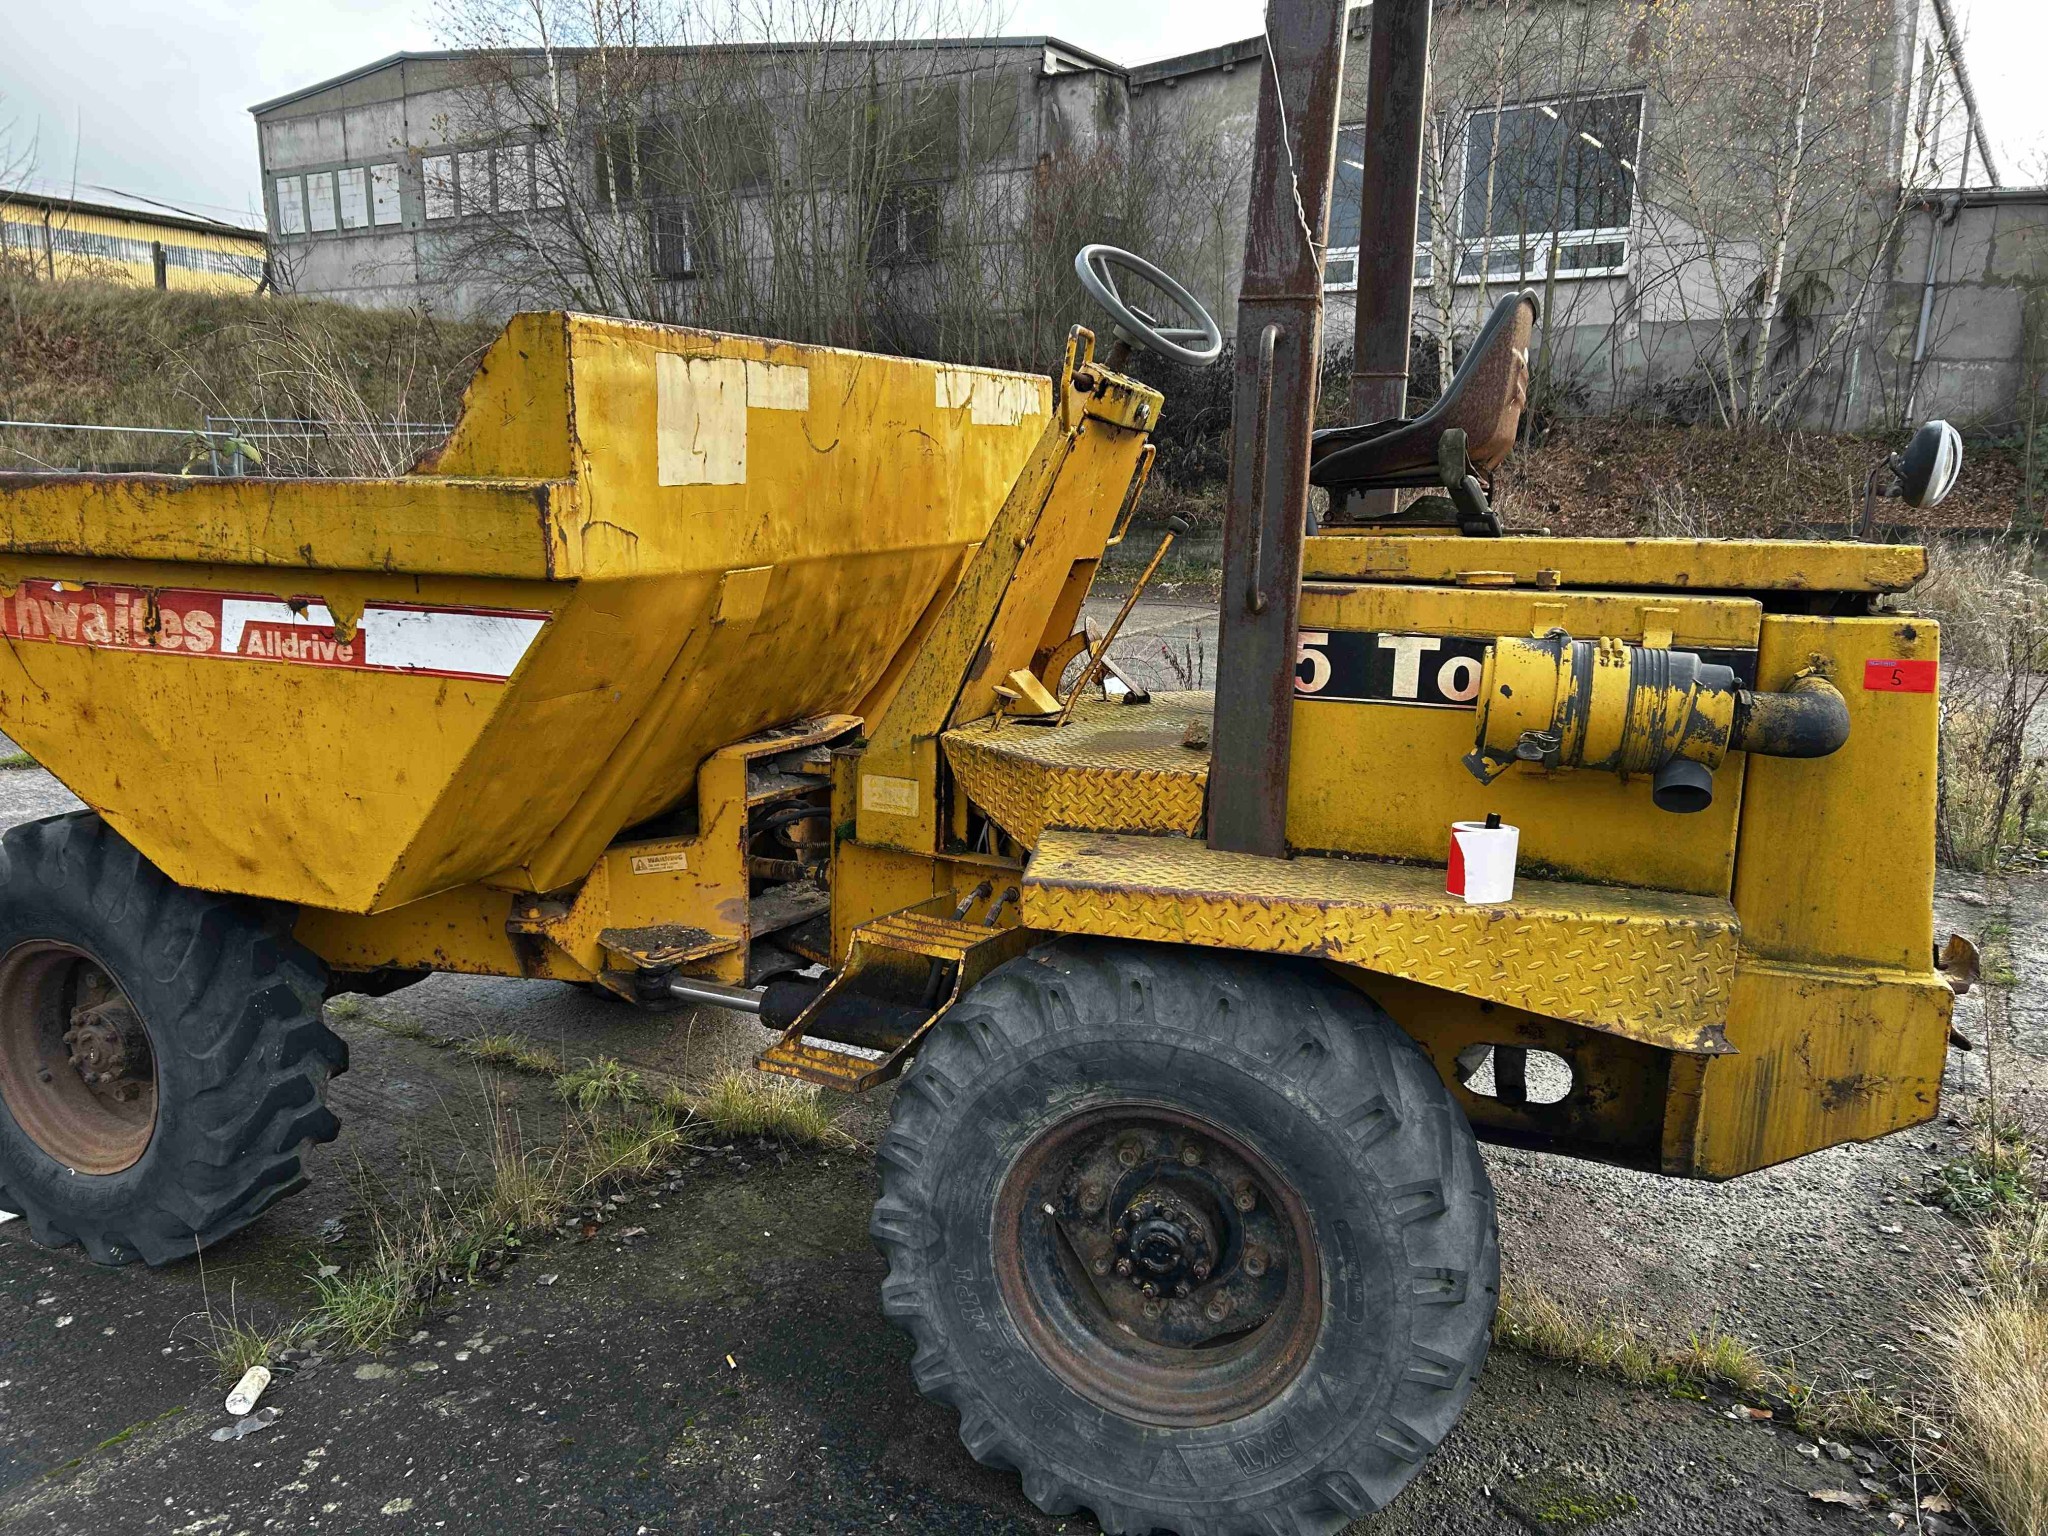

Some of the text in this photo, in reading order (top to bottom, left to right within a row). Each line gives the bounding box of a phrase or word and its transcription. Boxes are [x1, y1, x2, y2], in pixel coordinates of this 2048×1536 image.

[0, 583, 354, 662] hwaites Alldrive
[1891, 669, 1904, 685] 5
[1235, 1418, 1297, 1475] BKT
